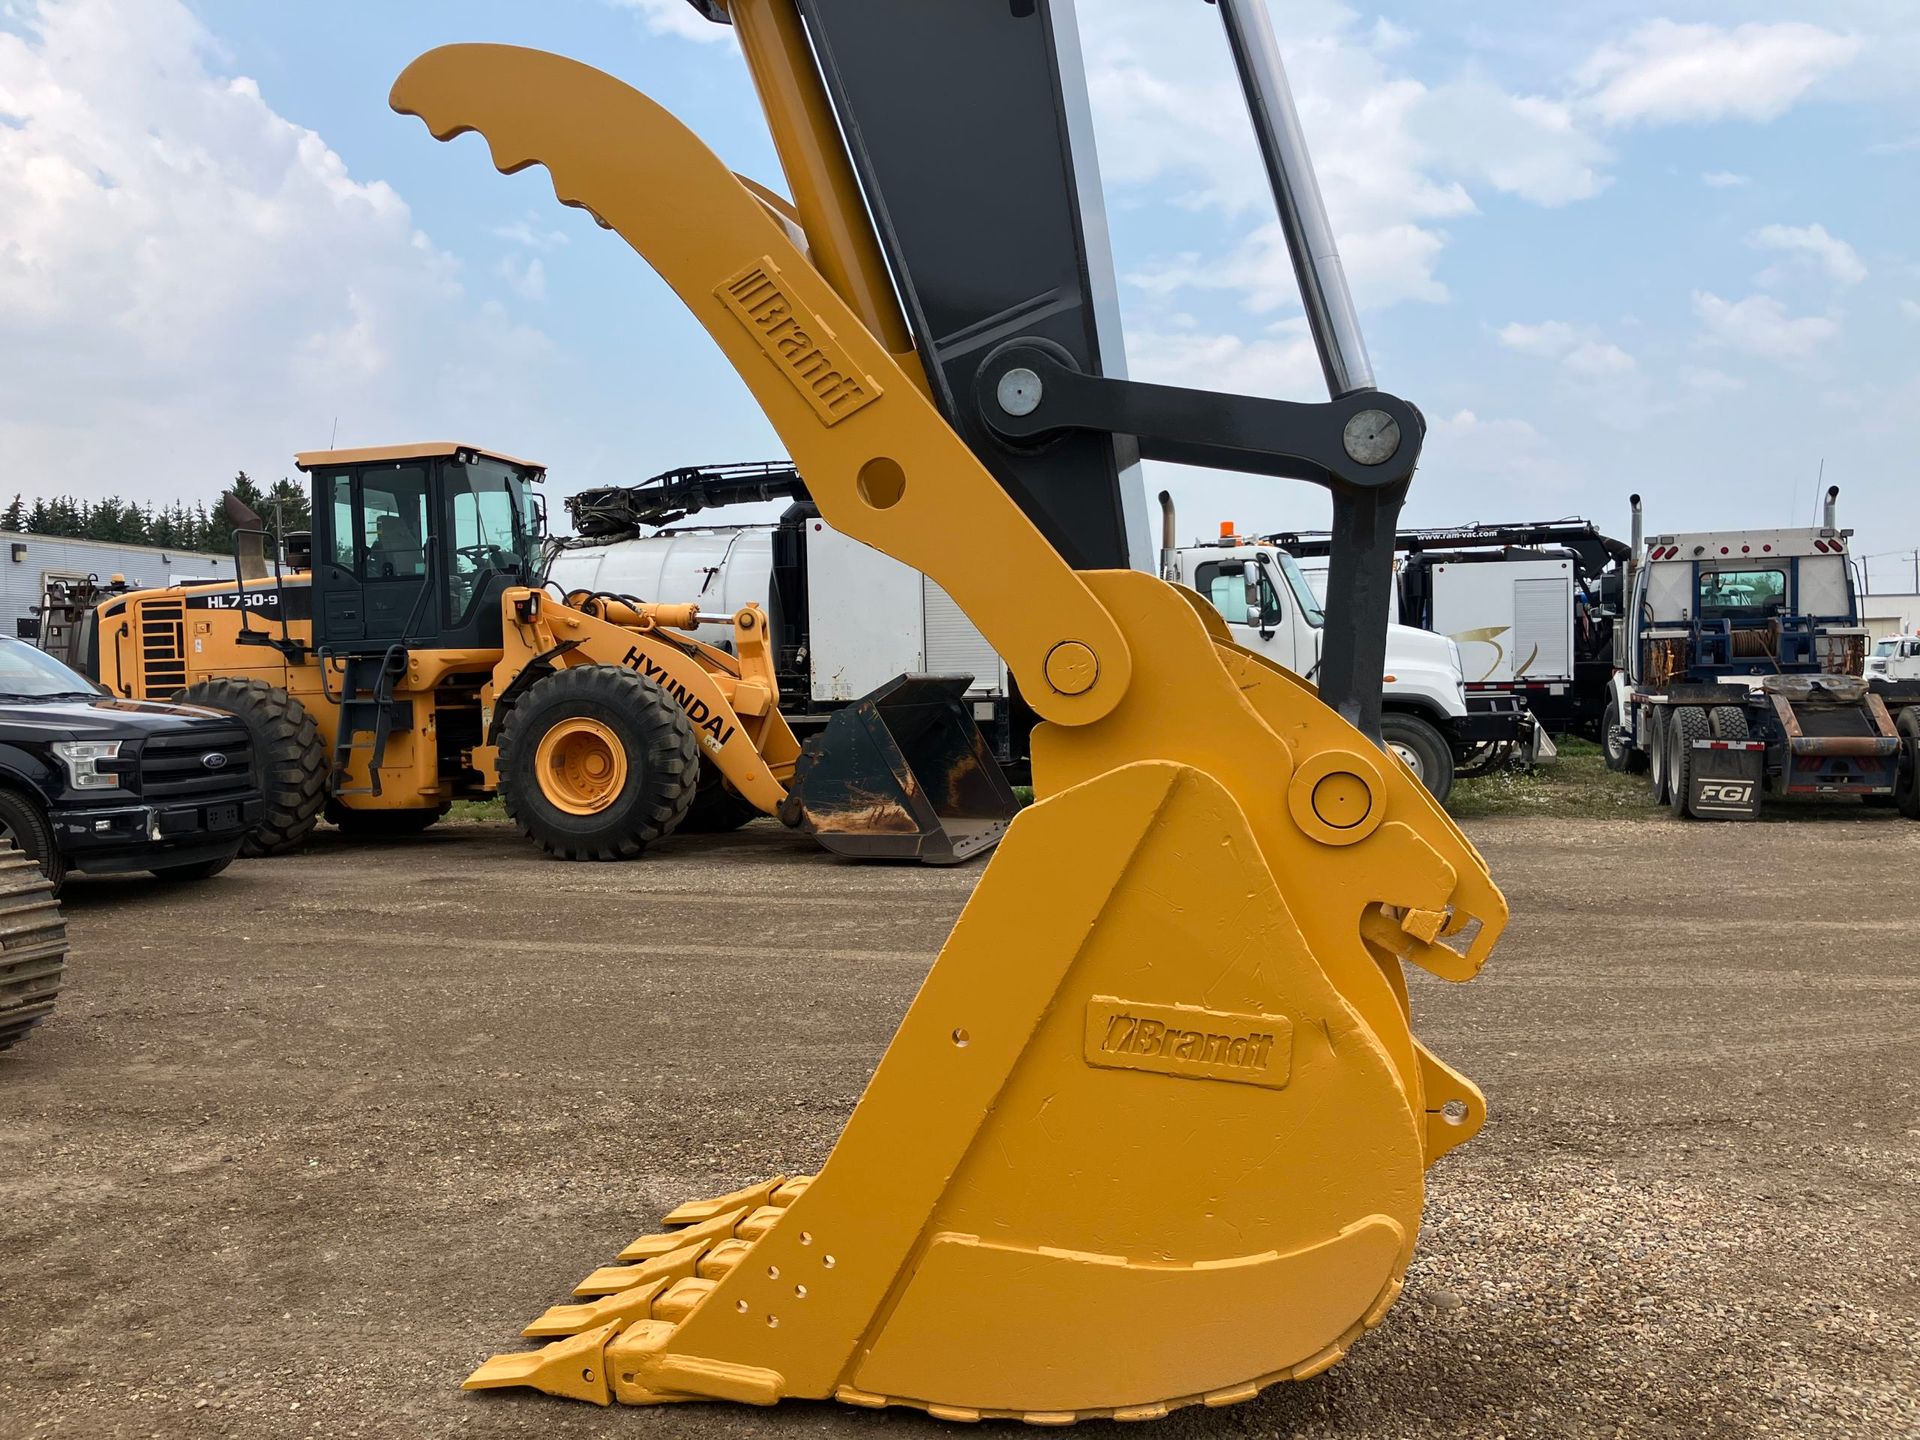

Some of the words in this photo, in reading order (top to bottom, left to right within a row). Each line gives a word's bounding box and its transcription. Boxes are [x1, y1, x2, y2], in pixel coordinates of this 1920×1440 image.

[746, 290, 865, 416] Brandt
[1417, 530, 1498, 541] www.ram-vac.com
[622, 646, 736, 746] HYUNDAI
[1700, 785, 1753, 802] FGI
[1129, 1017, 1274, 1071] Brandt
